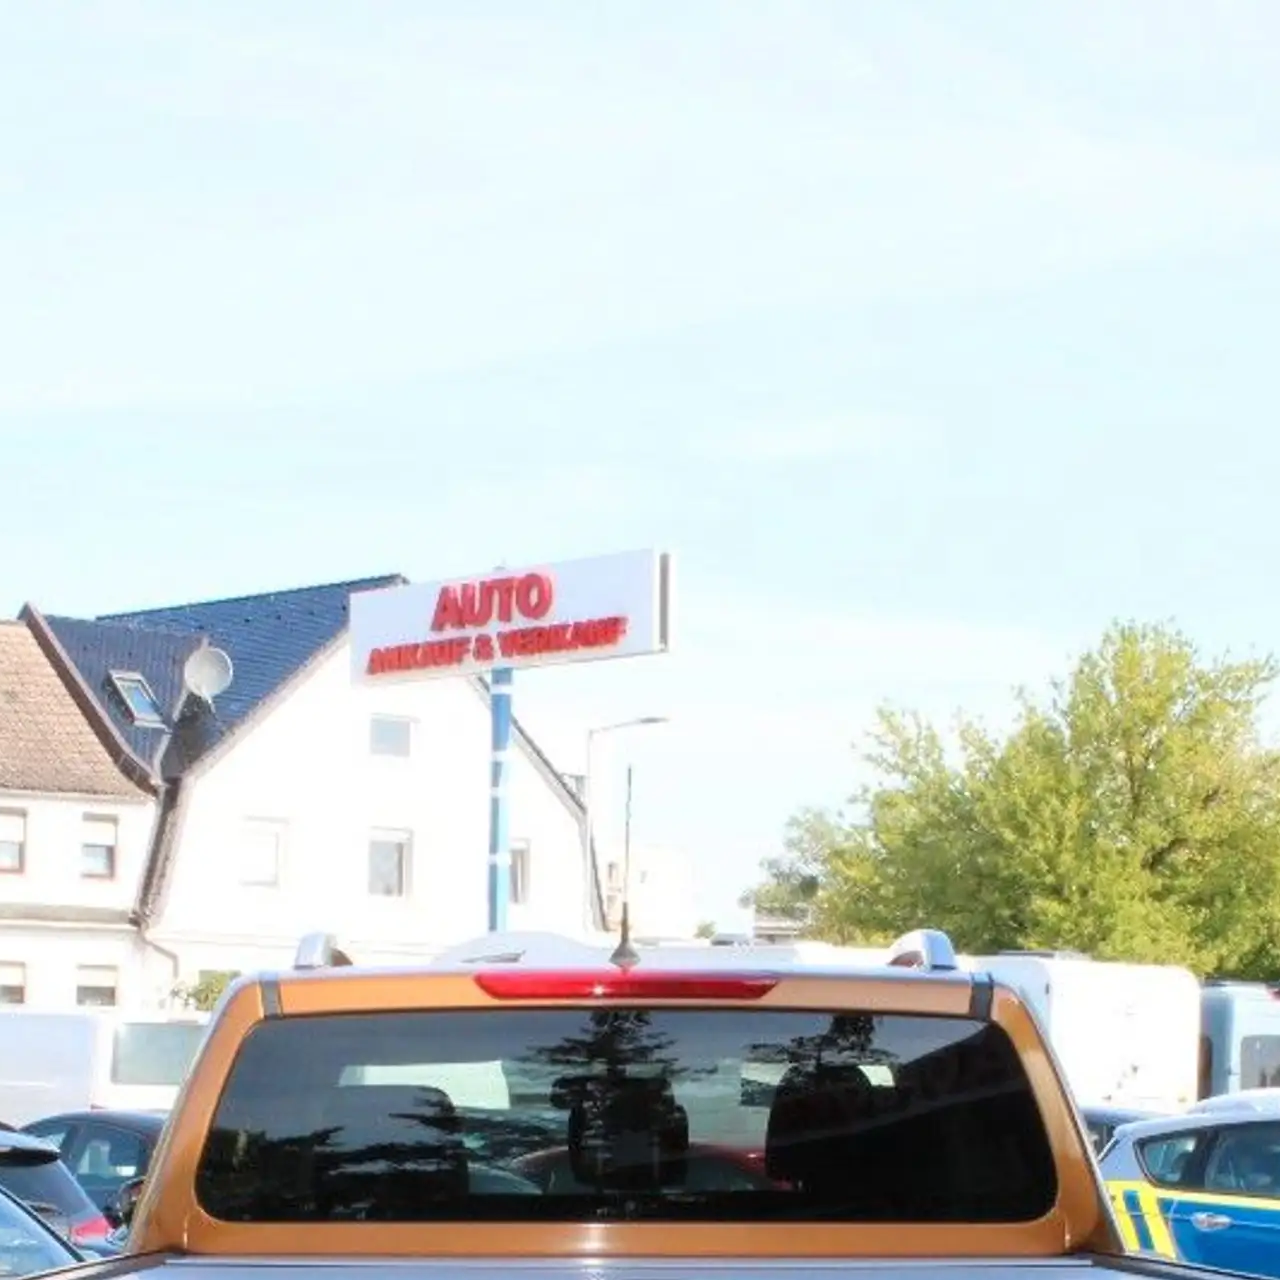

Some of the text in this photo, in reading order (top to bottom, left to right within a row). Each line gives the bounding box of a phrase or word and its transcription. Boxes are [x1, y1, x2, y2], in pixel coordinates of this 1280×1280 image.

[431, 573, 552, 631] AUTO
[367, 616, 627, 675] ANKAUF & VERKAUF
